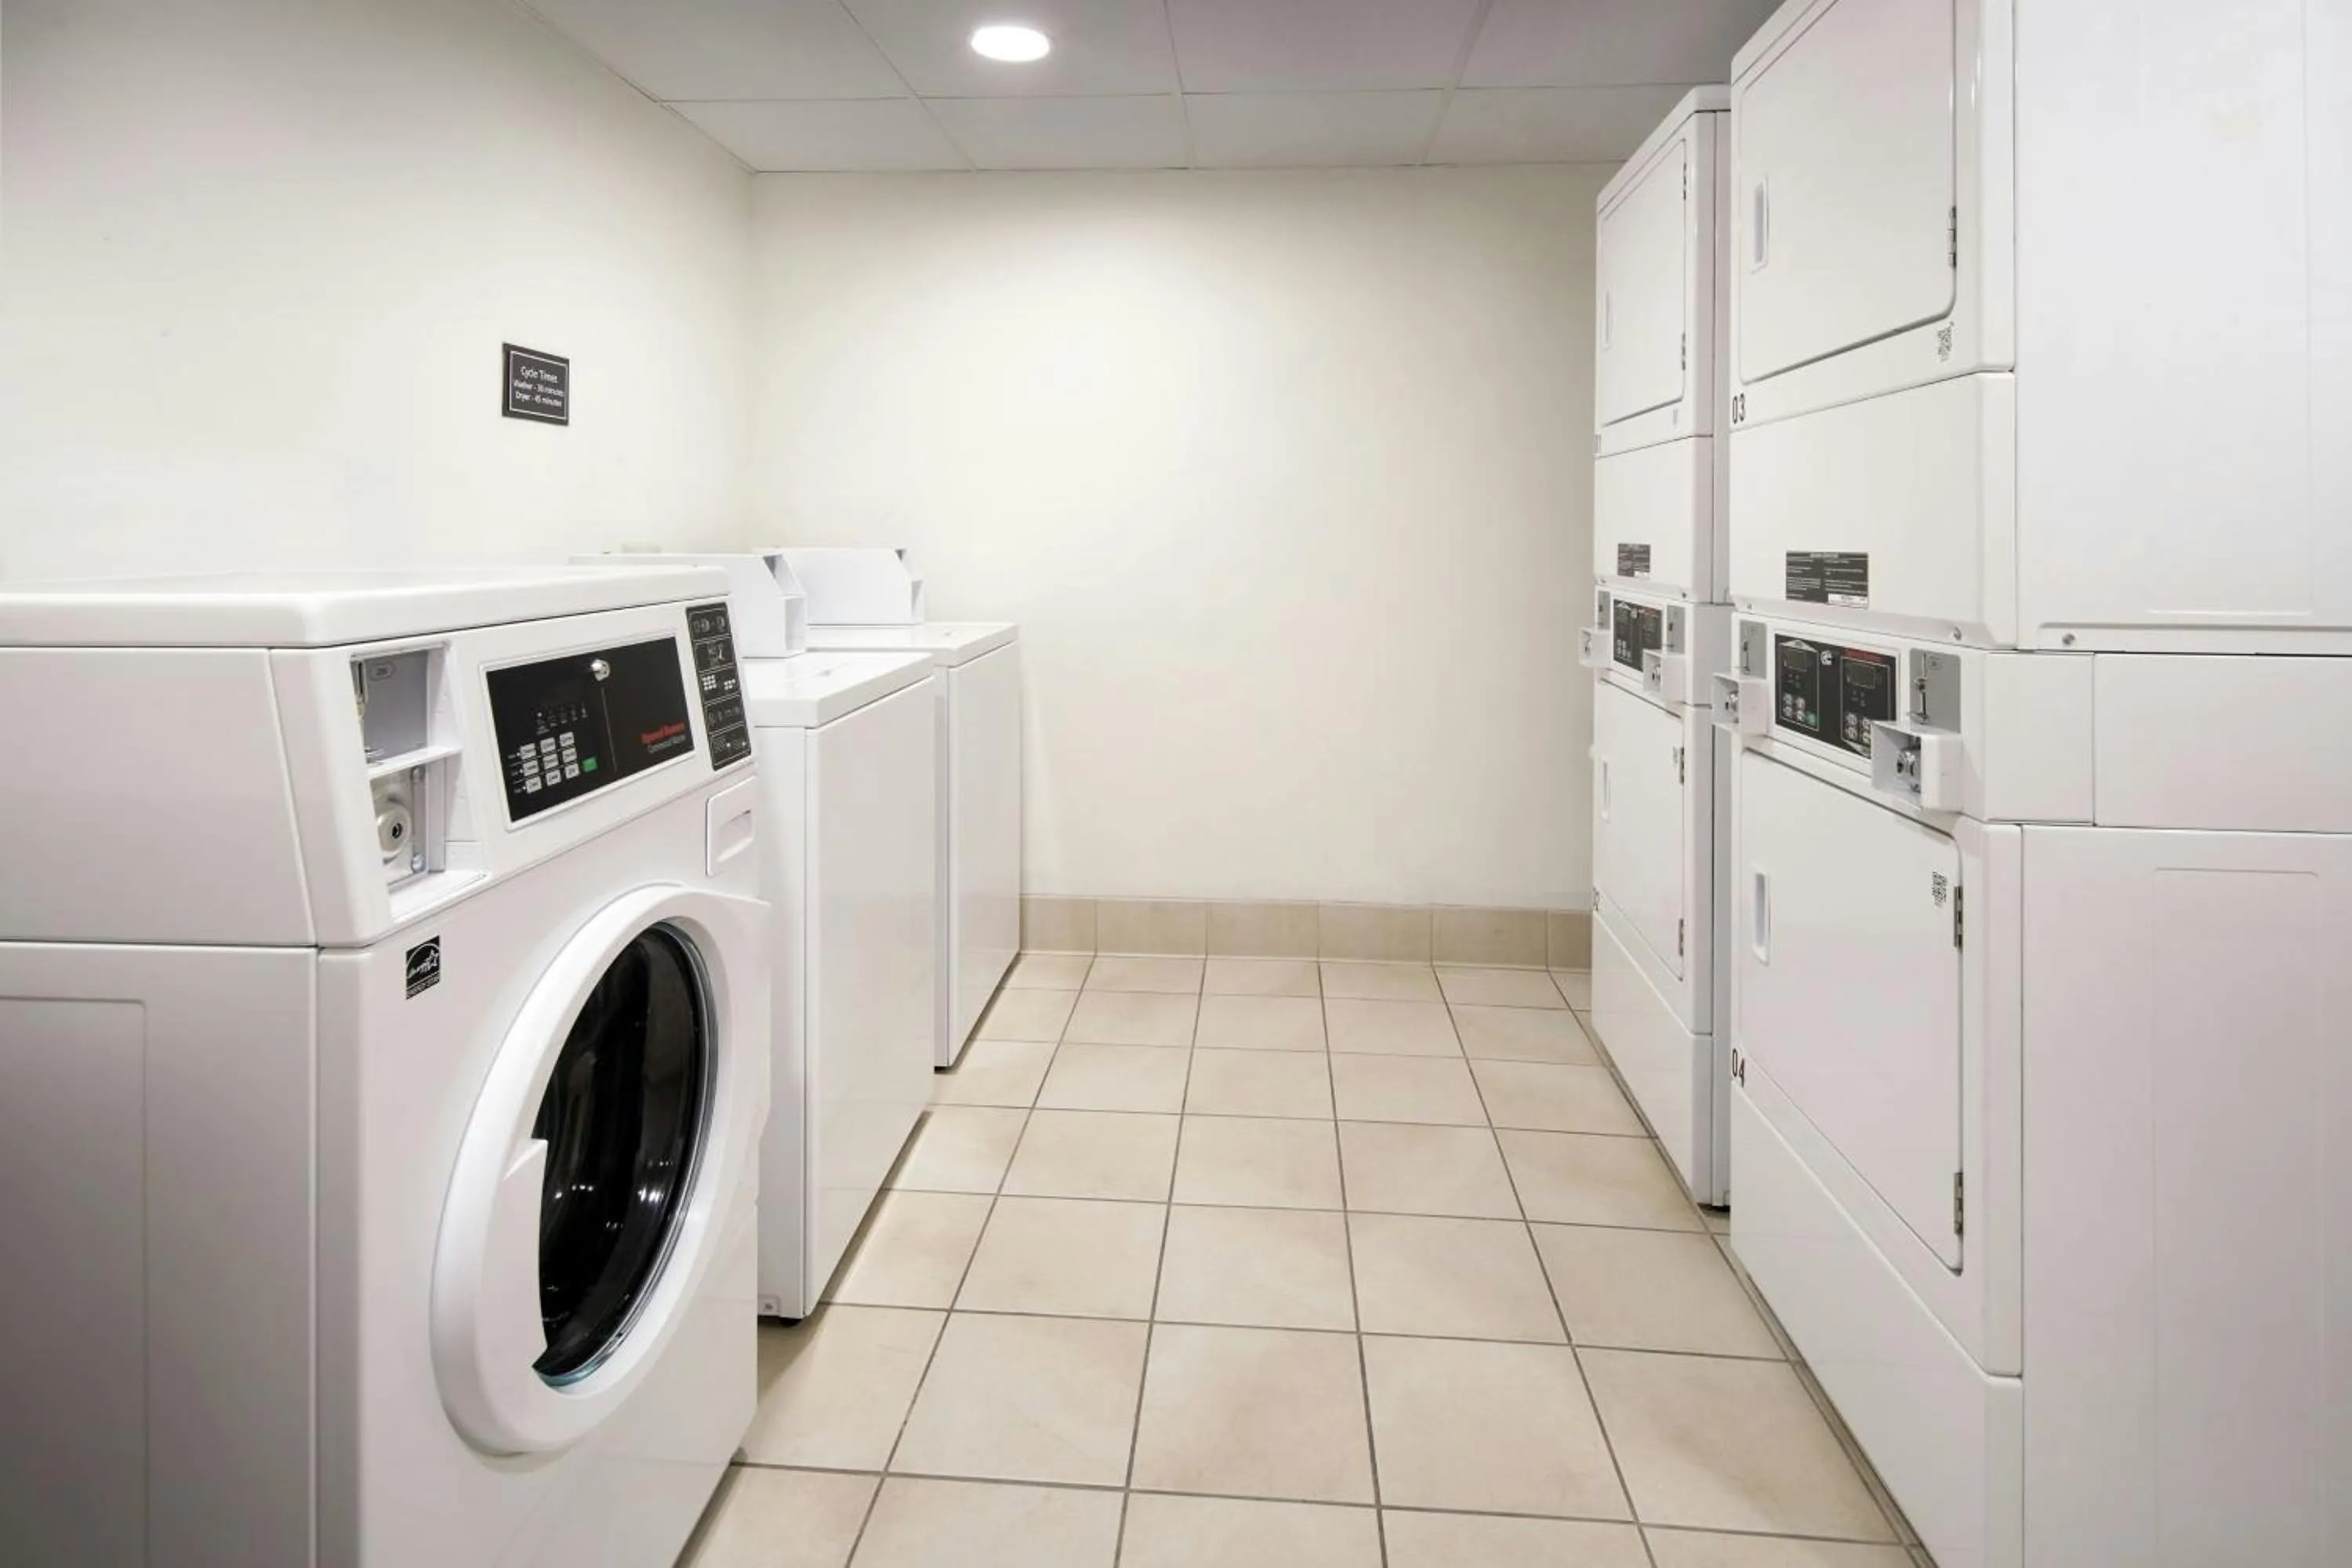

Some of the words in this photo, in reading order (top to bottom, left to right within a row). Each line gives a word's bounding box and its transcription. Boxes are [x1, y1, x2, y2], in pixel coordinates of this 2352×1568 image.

[520, 366, 539, 379] Cycle
[539, 369, 558, 383] Times
[1733, 393, 1745, 424] 03
[1732, 1047, 1744, 1088] 04
